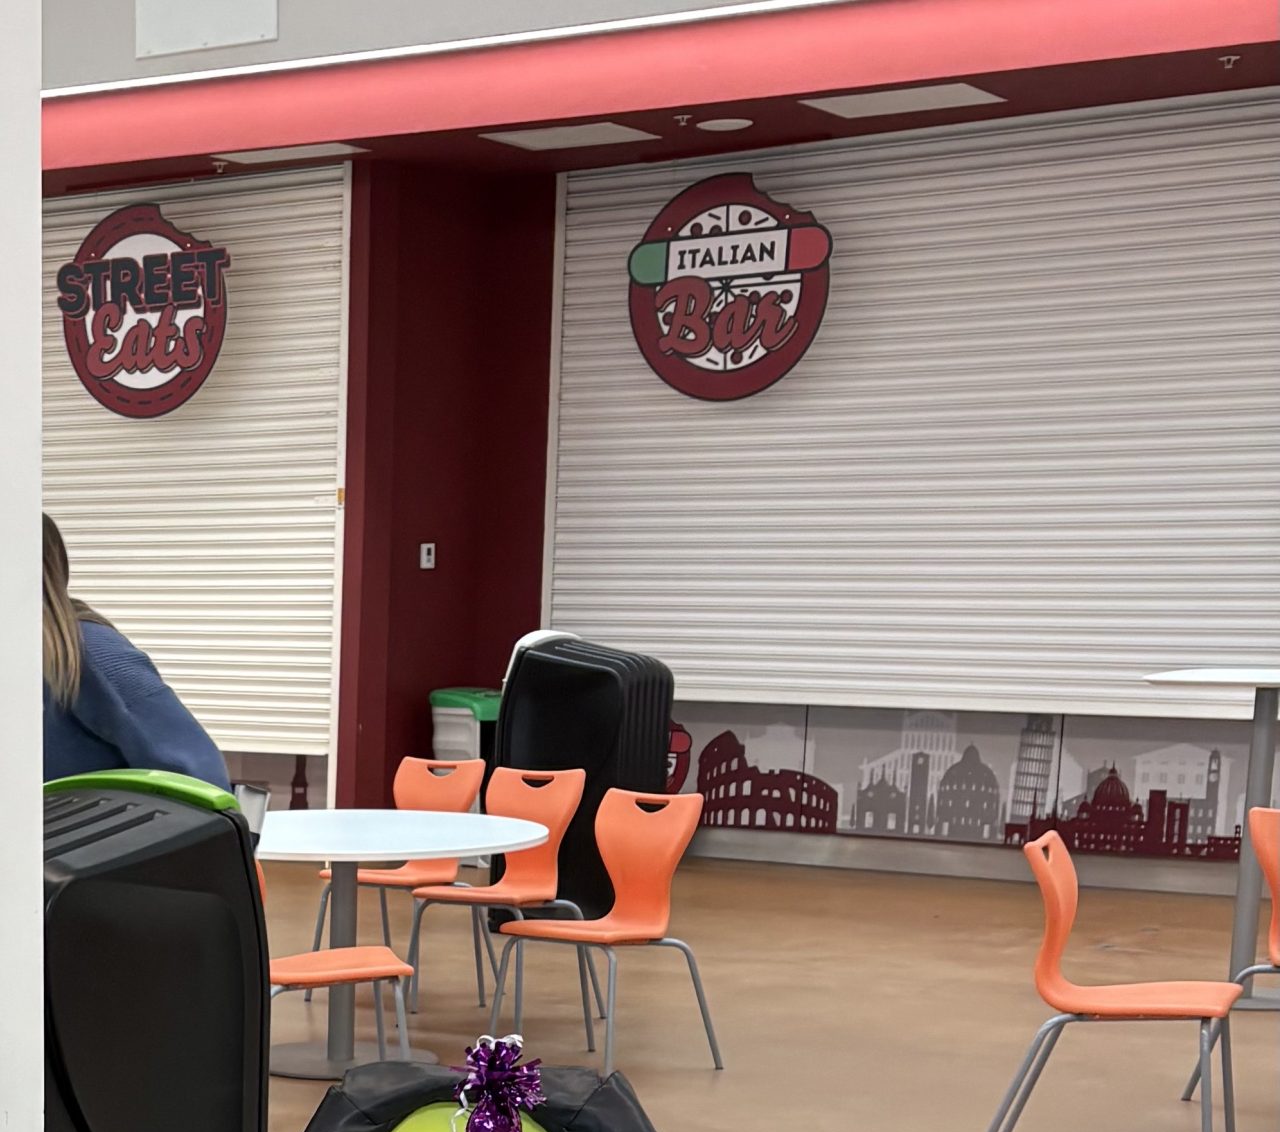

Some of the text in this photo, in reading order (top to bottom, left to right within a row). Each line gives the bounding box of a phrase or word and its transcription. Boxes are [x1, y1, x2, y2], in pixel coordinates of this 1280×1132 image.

[57, 248, 231, 319] STREET
[677, 241, 776, 270] ITALIAN
[87, 302, 206, 380] Eats
[656, 275, 798, 358] Bar
